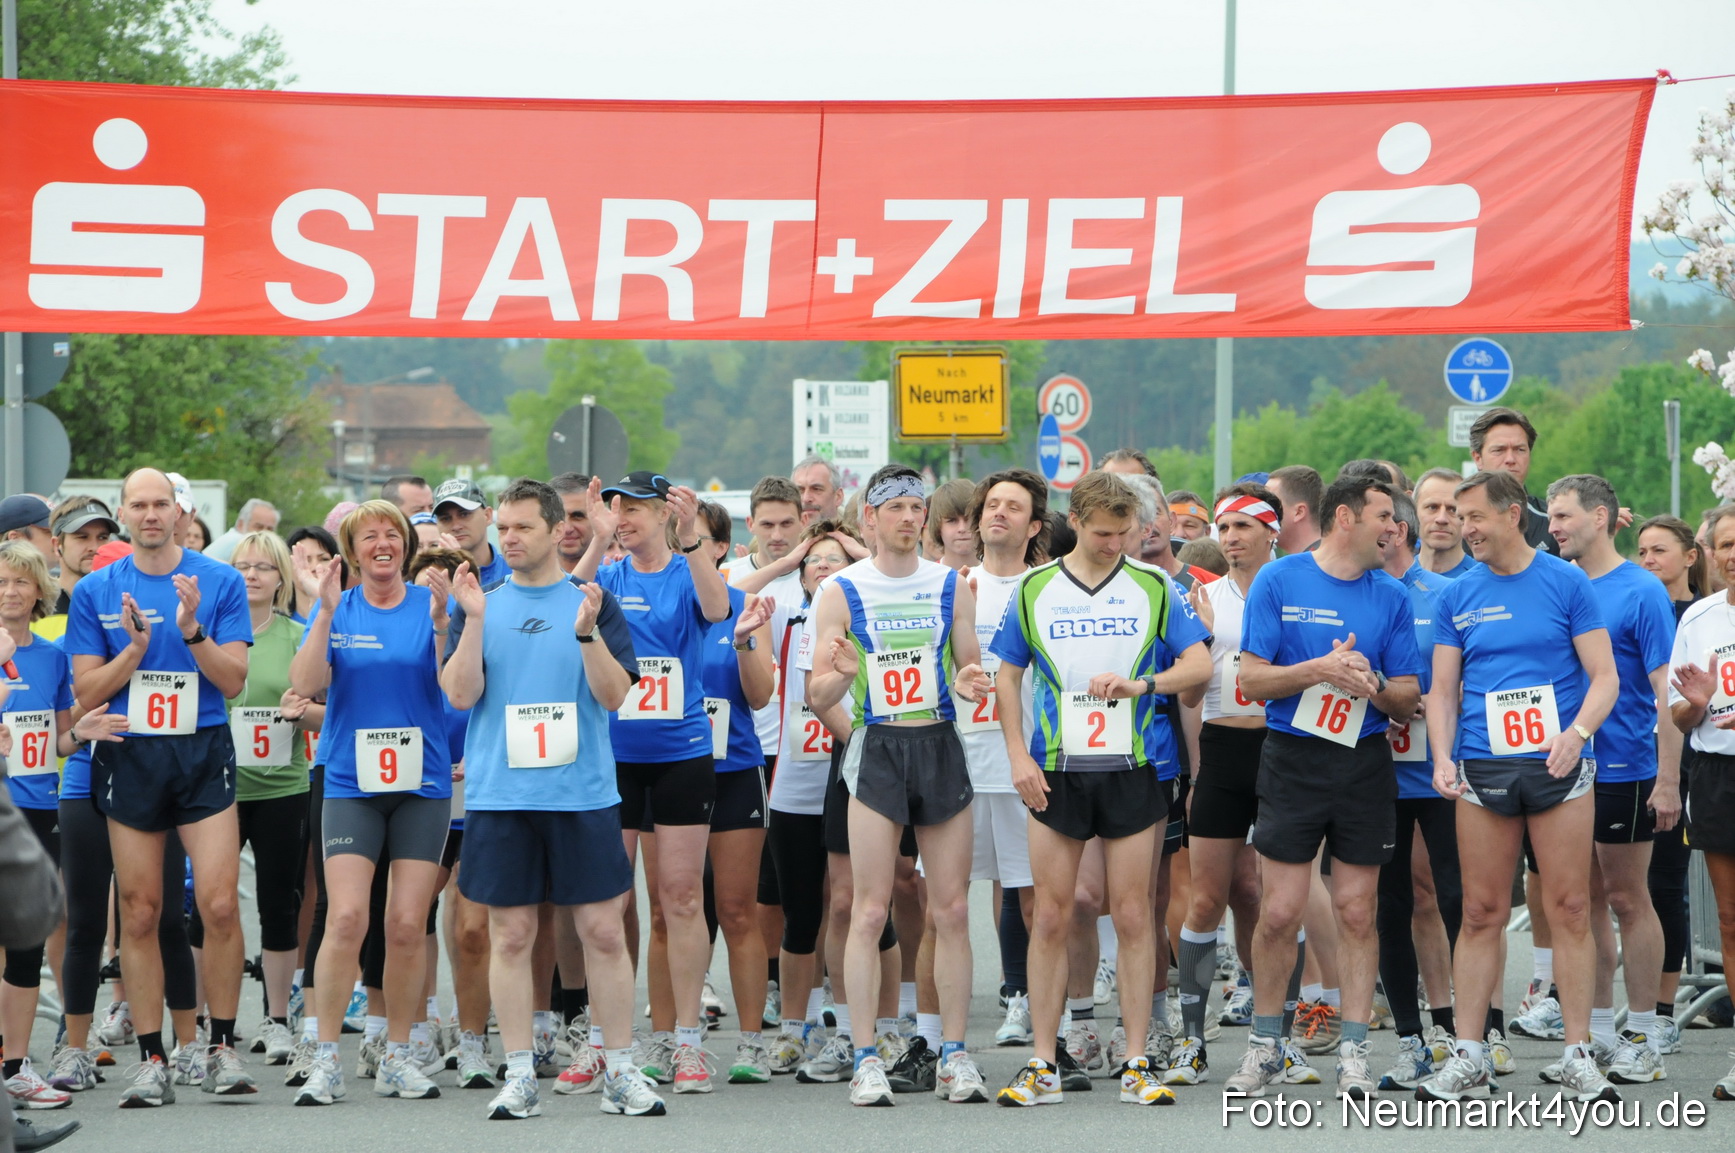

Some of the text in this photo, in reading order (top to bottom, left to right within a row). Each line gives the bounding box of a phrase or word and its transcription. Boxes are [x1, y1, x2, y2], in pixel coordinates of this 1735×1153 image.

[937, 368, 967, 378] Nach
[909, 384, 995, 404] Neumarkt
[1052, 392, 1079, 417] 60
[939, 412, 969, 422] 5 km
[1051, 605, 1091, 614] TEAM
[874, 616, 938, 631] BOCK
[1050, 618, 1138, 639] BOCK
[877, 652, 908, 662] MEYER
[878, 660, 909, 668] WERBUNG
[141, 674, 172, 682] MEYER
[638, 675, 668, 711] 21
[883, 667, 923, 707] 92
[1497, 691, 1527, 702] MEYER
[15, 715, 43, 723] MEYER
[147, 693, 178, 729] 61
[243, 710, 271, 718] MEYER
[518, 706, 550, 716] MEYER
[1316, 693, 1352, 734] 16
[366, 732, 398, 740] MEYER
[1087, 711, 1106, 748] 2
[1503, 708, 1545, 747] 66
[253, 725, 270, 758] 5
[533, 722, 546, 758] 1
[22, 731, 49, 768] 67
[379, 748, 397, 784] 9
[326, 837, 353, 847] ODLO
